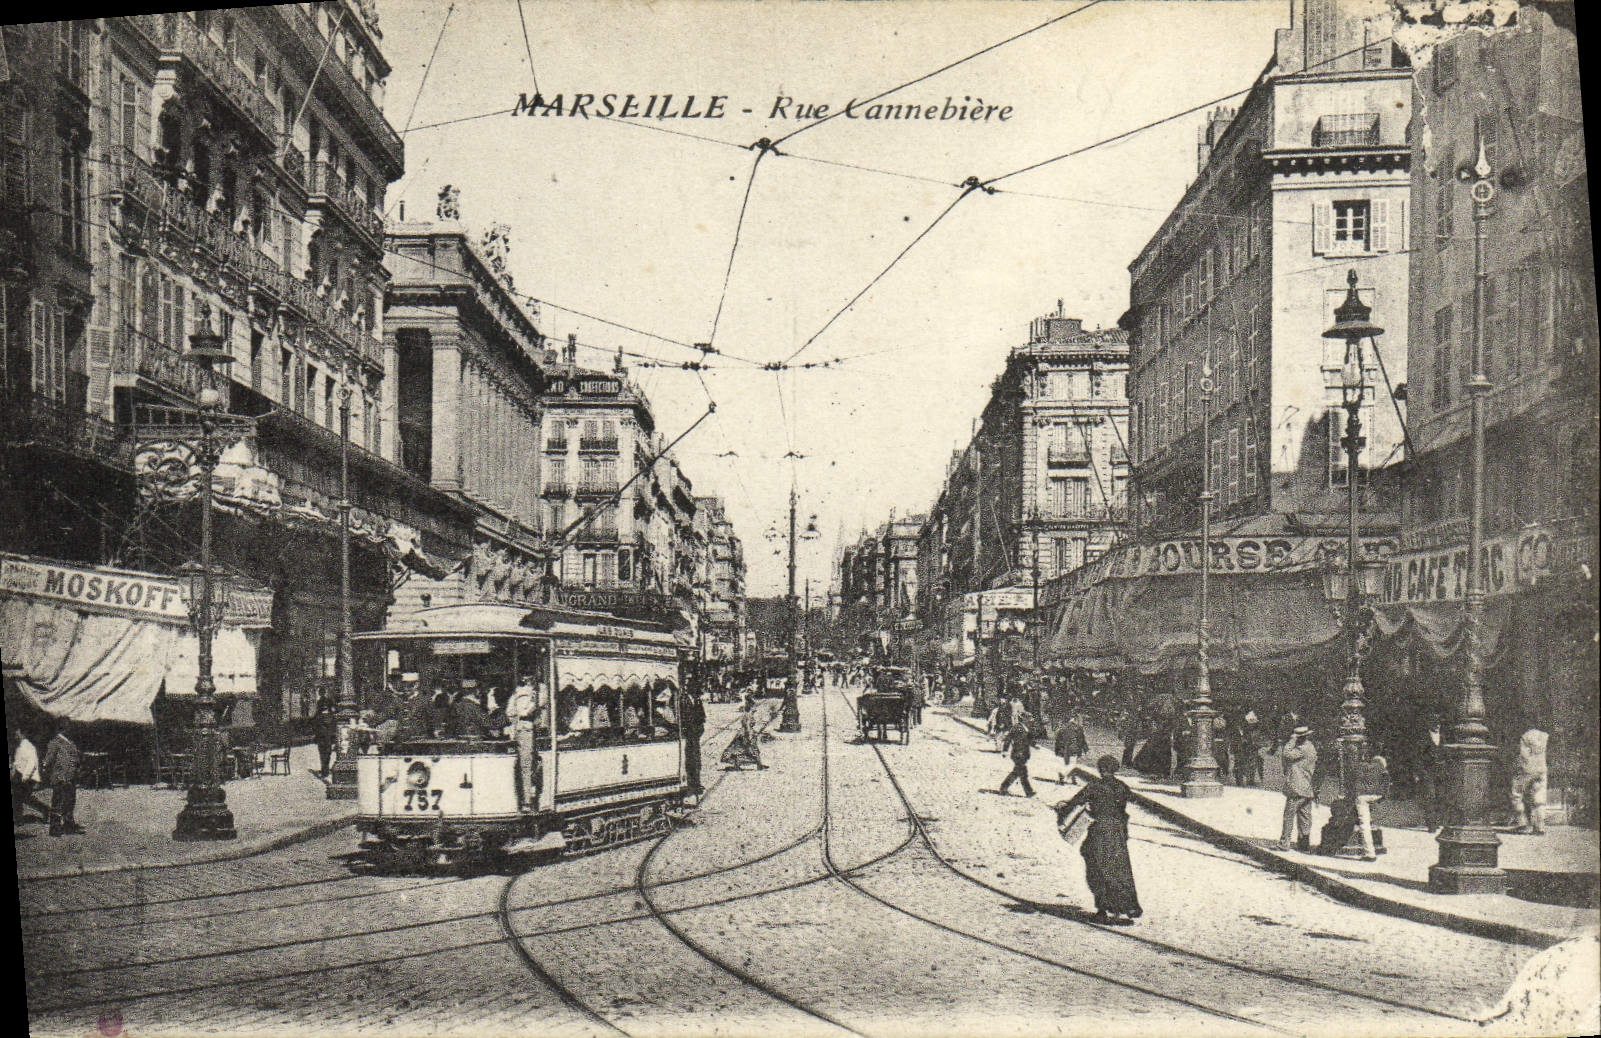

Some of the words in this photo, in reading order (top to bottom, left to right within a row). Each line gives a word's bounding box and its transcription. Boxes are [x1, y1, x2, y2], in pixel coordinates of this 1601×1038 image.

[44, 569, 178, 610] MOSKOFF
[568, 593, 617, 607] GRAND
[403, 789, 443, 811] 757
